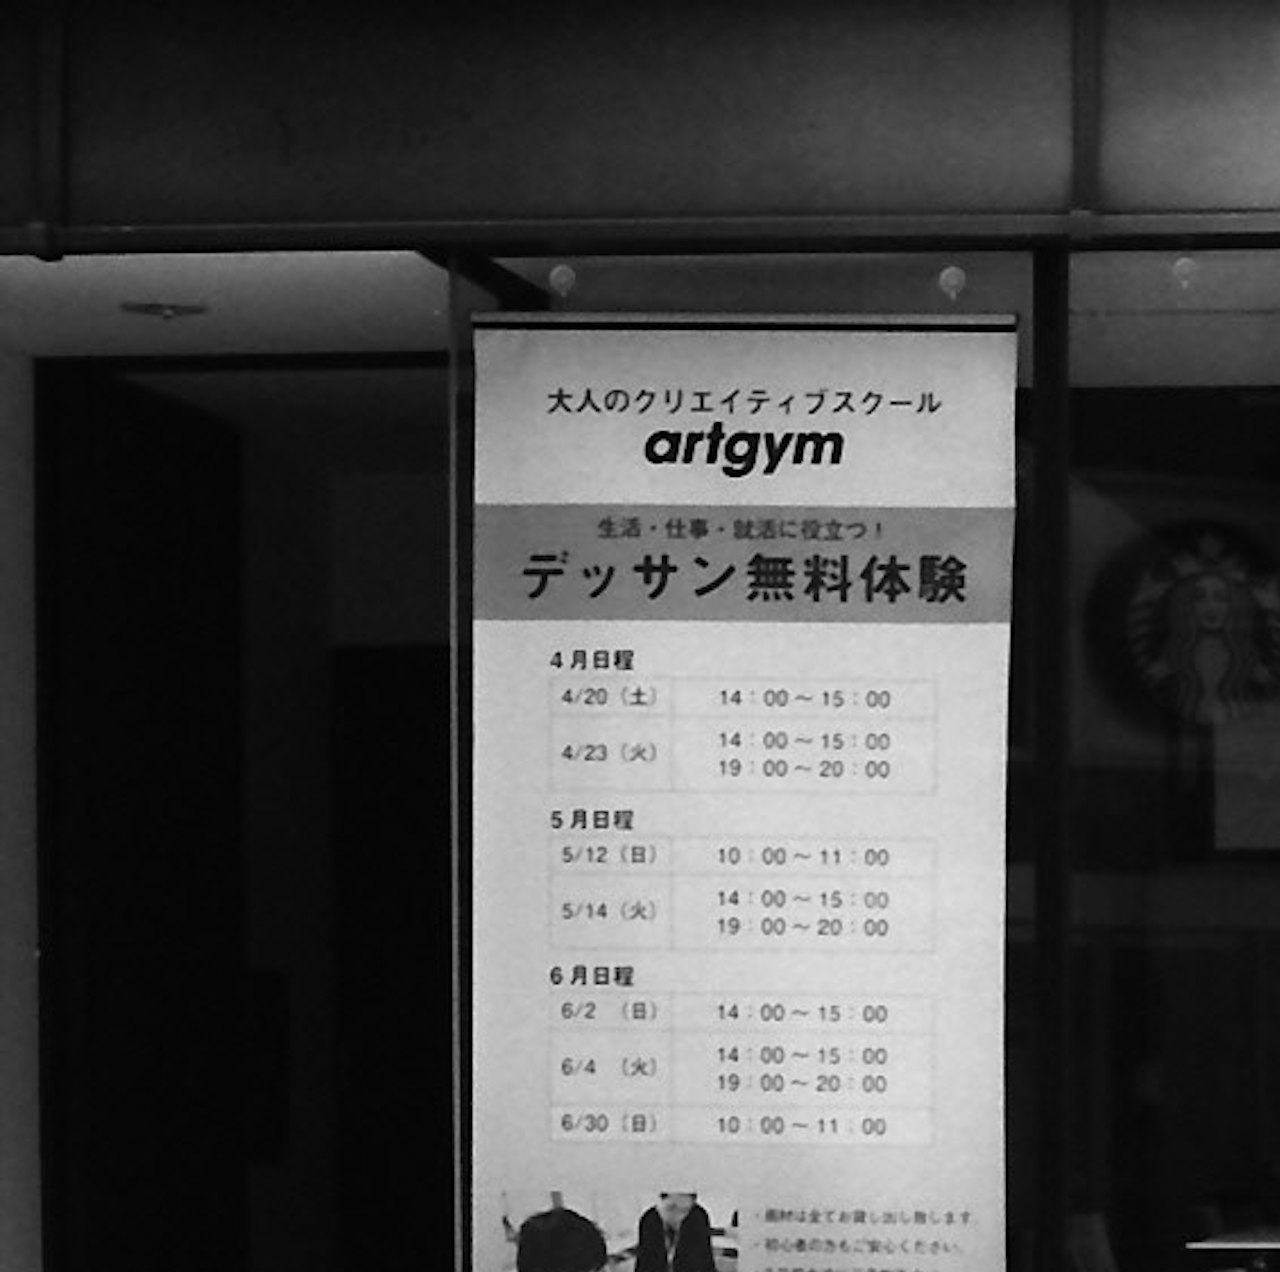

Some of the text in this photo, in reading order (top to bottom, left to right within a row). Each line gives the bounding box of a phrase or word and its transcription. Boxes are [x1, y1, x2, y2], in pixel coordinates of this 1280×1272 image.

[546, 387, 943, 416] 大人のクリエイティブスクール
[643, 421, 846, 479] artgym
[521, 550, 969, 604] デッサン無料体験
[549, 649, 635, 671] 4月日程
[550, 808, 635, 831] 5月日程
[549, 965, 635, 988] 6月日程
